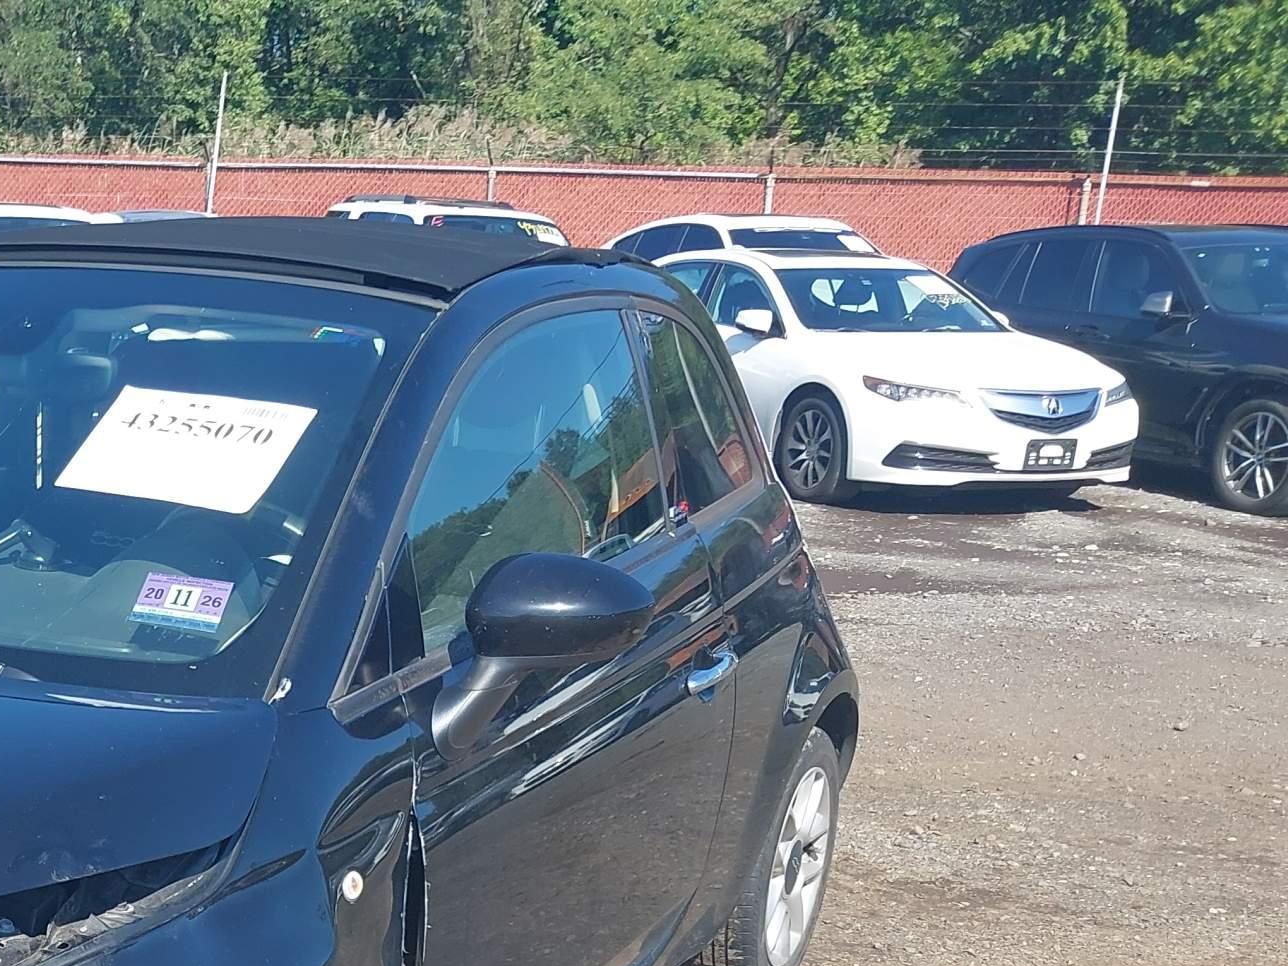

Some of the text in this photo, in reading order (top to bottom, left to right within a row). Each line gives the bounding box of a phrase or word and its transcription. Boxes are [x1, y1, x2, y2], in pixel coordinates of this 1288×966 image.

[122, 412, 273, 445] 43255070
[144, 587, 223, 608] 20 11 26
